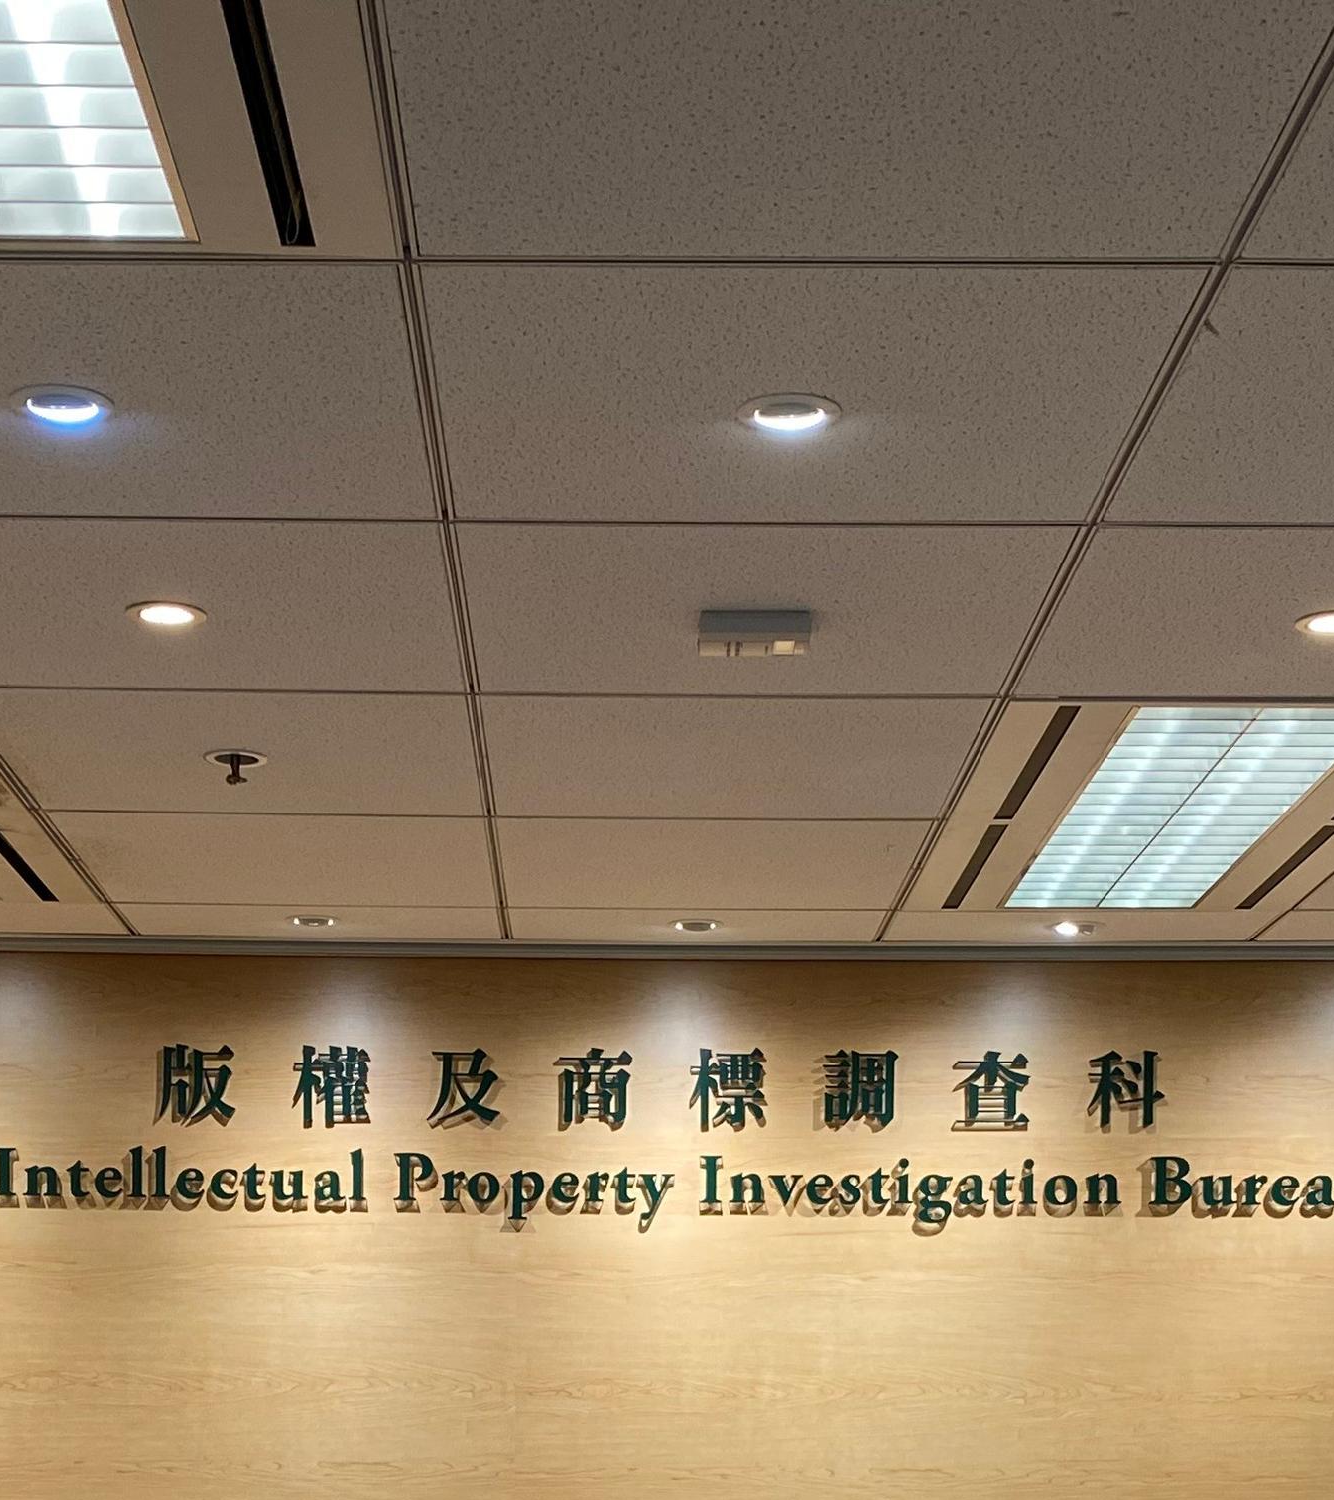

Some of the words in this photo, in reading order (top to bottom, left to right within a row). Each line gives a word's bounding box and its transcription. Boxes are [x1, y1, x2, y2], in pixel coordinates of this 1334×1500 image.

[155, 1044, 1165, 1129] 版權及商標調查科
[393, 1152, 675, 1220] Property
[699, 1155, 1121, 1222] Investigation
